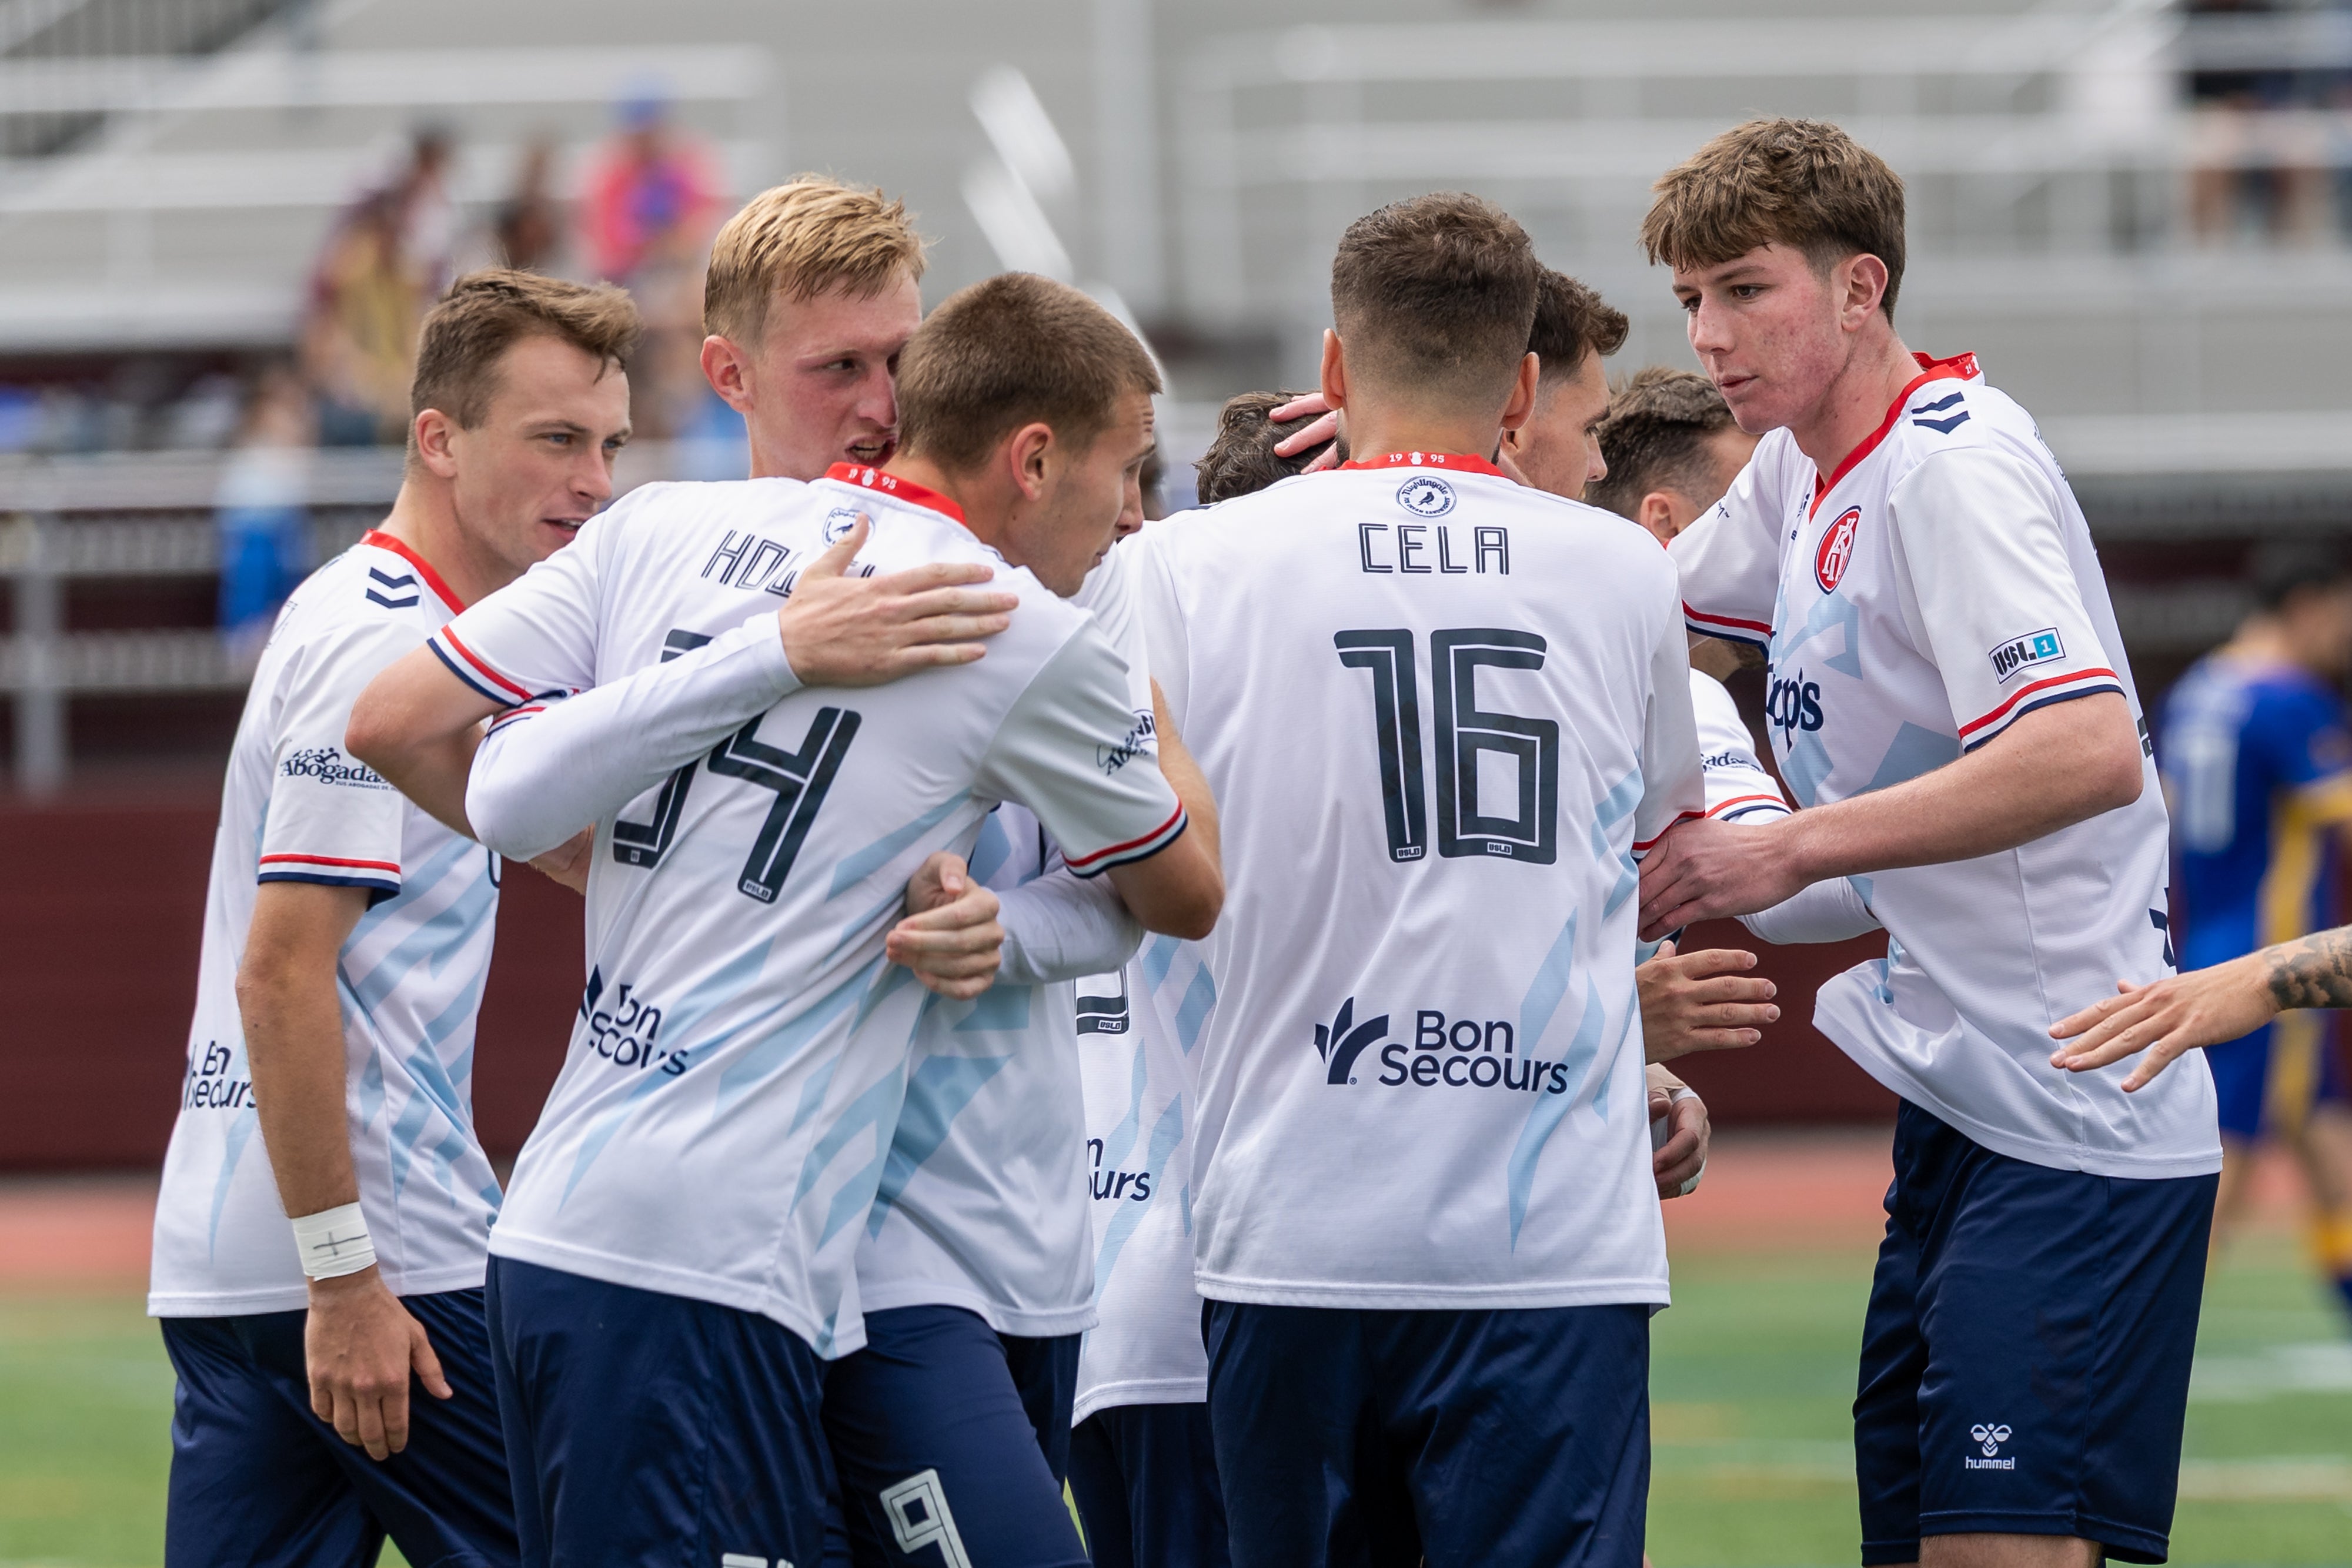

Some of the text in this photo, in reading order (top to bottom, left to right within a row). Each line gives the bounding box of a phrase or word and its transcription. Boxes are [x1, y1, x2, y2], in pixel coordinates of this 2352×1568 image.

[1389, 453, 1445, 463] 19 95
[883, 476, 897, 490] 95
[1358, 523, 1509, 575] CELA
[1334, 627, 1559, 864] 16
[1415, 1010, 1514, 1054] Bon
[1378, 1043, 1569, 1095] Secours
[1966, 1455, 2016, 1470] hummel
